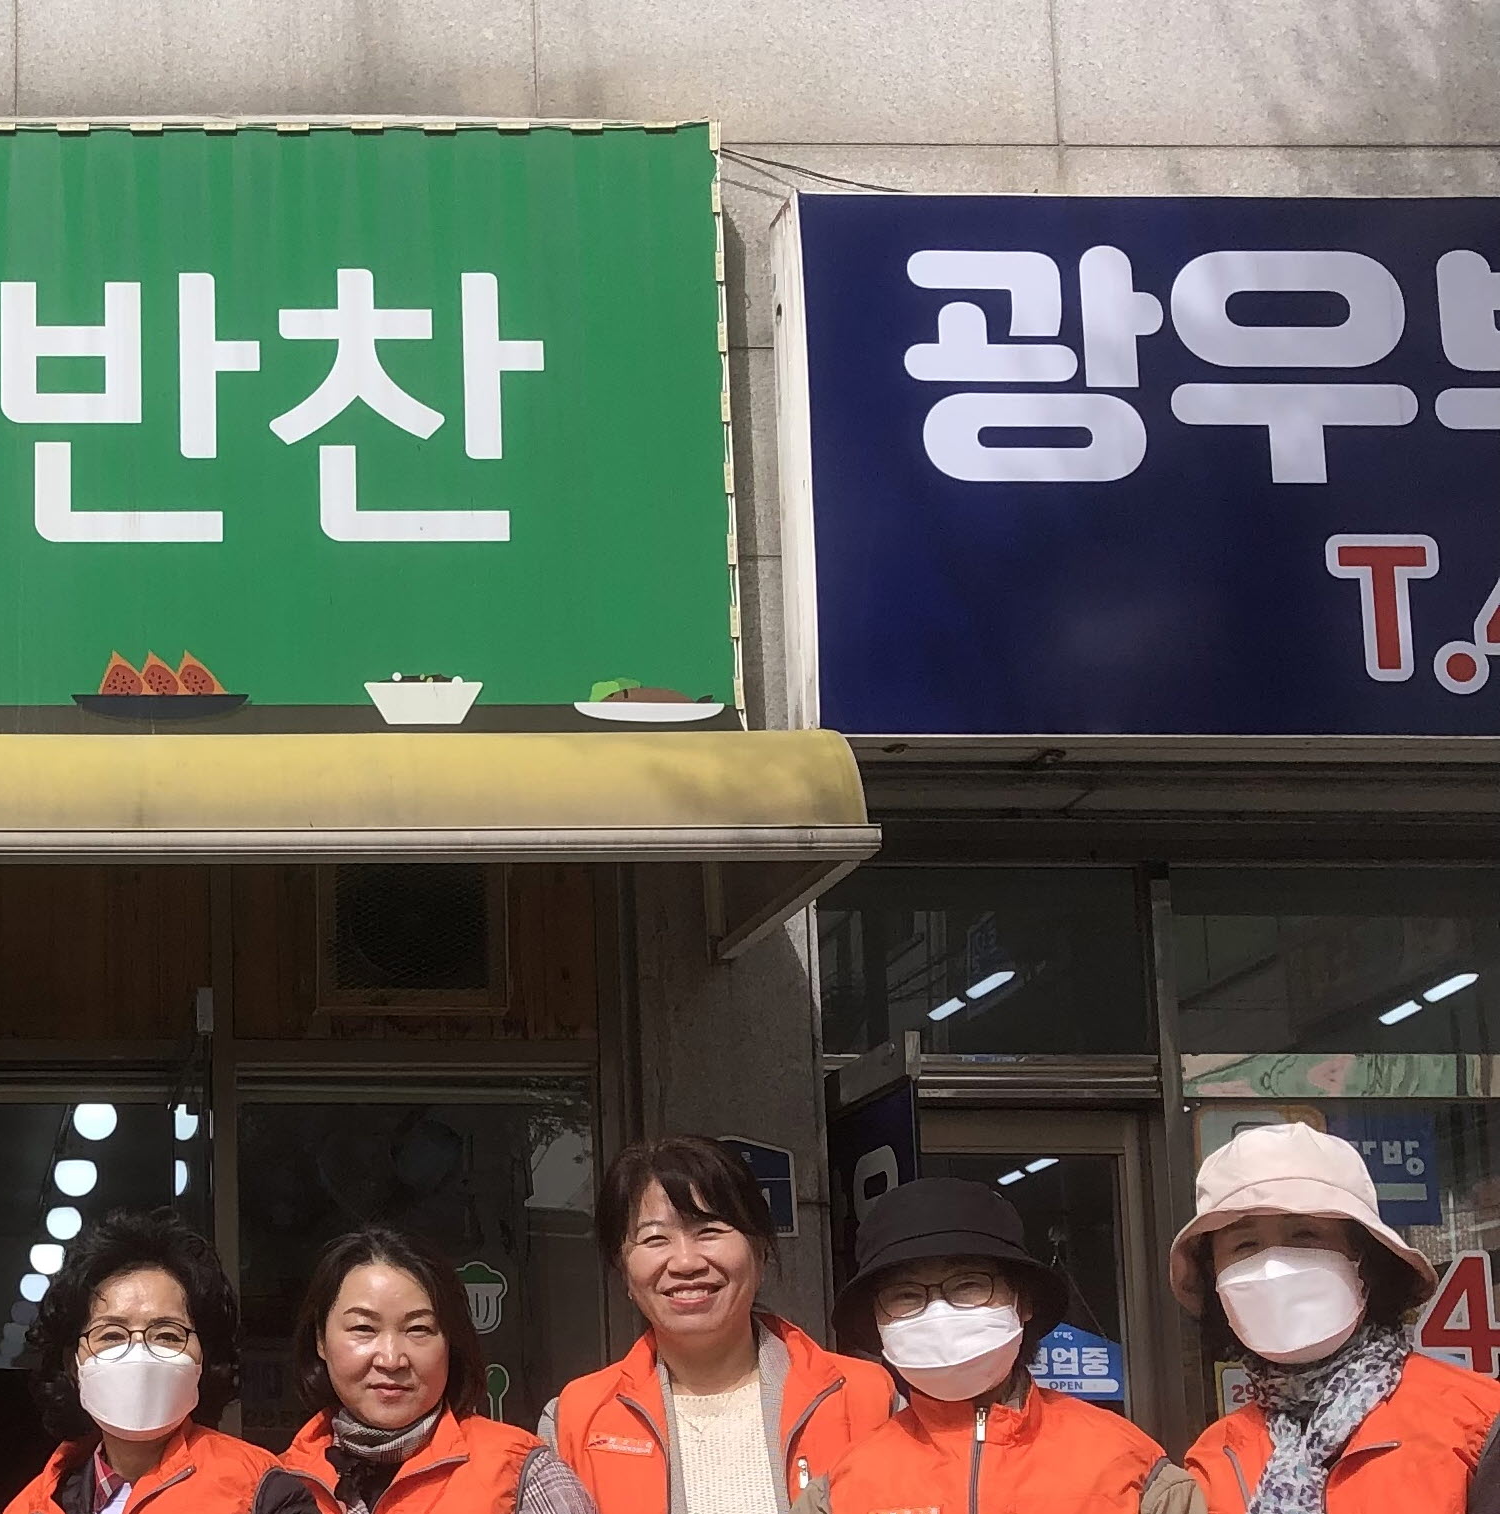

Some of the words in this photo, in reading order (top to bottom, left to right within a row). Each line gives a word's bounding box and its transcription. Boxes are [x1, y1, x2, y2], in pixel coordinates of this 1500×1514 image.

[0, 268, 544, 542] 반찬
[904, 246, 1500, 482] 광우
[1325, 534, 1500, 694] T.
[1049, 1381, 1083, 1390] OPEN
